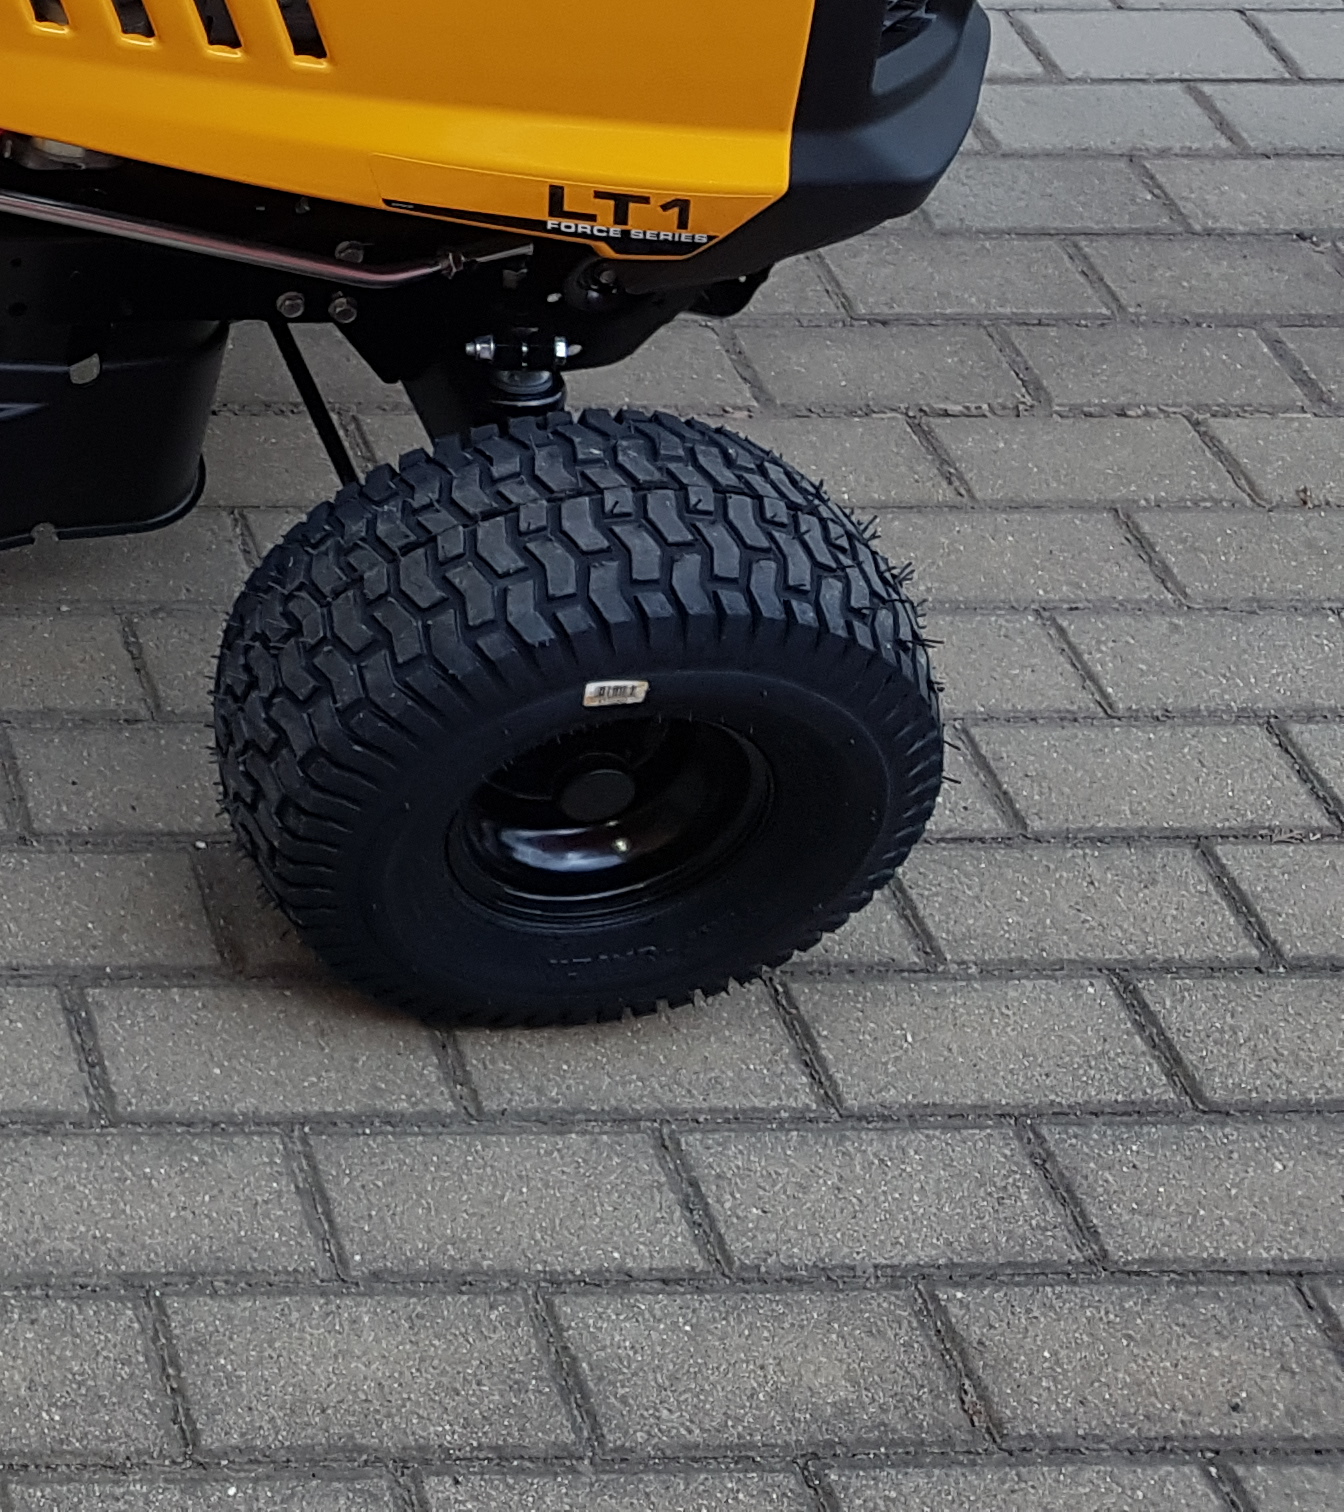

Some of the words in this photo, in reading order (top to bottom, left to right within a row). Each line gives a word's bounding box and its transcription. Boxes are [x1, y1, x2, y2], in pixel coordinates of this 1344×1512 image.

[548, 184, 692, 230] LT1
[546, 220, 623, 238] FORCE
[629, 228, 708, 244] SERIES
